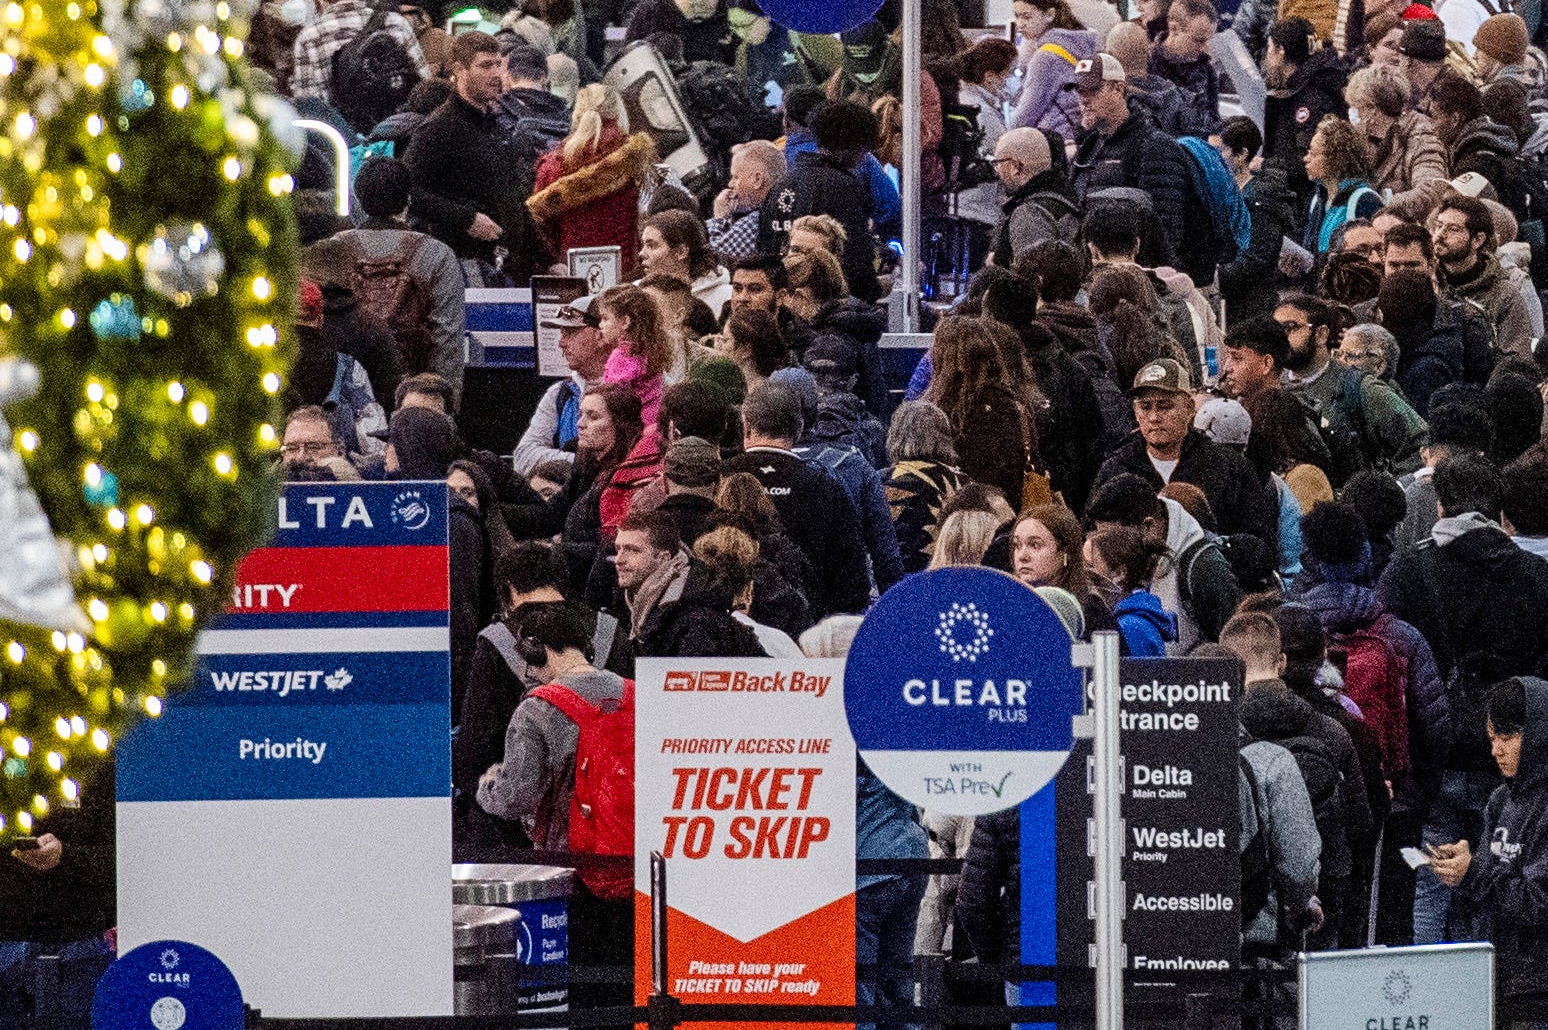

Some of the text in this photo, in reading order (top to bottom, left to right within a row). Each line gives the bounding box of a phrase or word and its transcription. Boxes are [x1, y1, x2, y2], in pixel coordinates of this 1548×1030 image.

[277, 496, 374, 529] LTA
[210, 670, 324, 697] WESTJET
[731, 670, 788, 692] Back
[789, 670, 831, 698] Bay
[903, 679, 1027, 706] CLEAR
[988, 709, 1028, 723] PLUS
[239, 737, 327, 764] Priority
[660, 738, 832, 754] PRIORITY ACCESS LINE
[951, 763, 982, 772] WITH
[1133, 765, 1193, 785] Delta
[671, 767, 823, 811] TICKET
[924, 778, 957, 794] TSA
[1133, 788, 1187, 798] Main Cabin
[662, 816, 831, 860] TO SKIP
[1133, 827, 1226, 848] WestJet
[1133, 851, 1168, 863] Priority
[1133, 893, 1234, 911] Accessible
[148, 972, 190, 983] CLEAR
[688, 961, 806, 978] Please have your
[674, 978, 821, 996] TICKET TO SKIP ready
[1365, 1014, 1430, 1030] CLEAR
